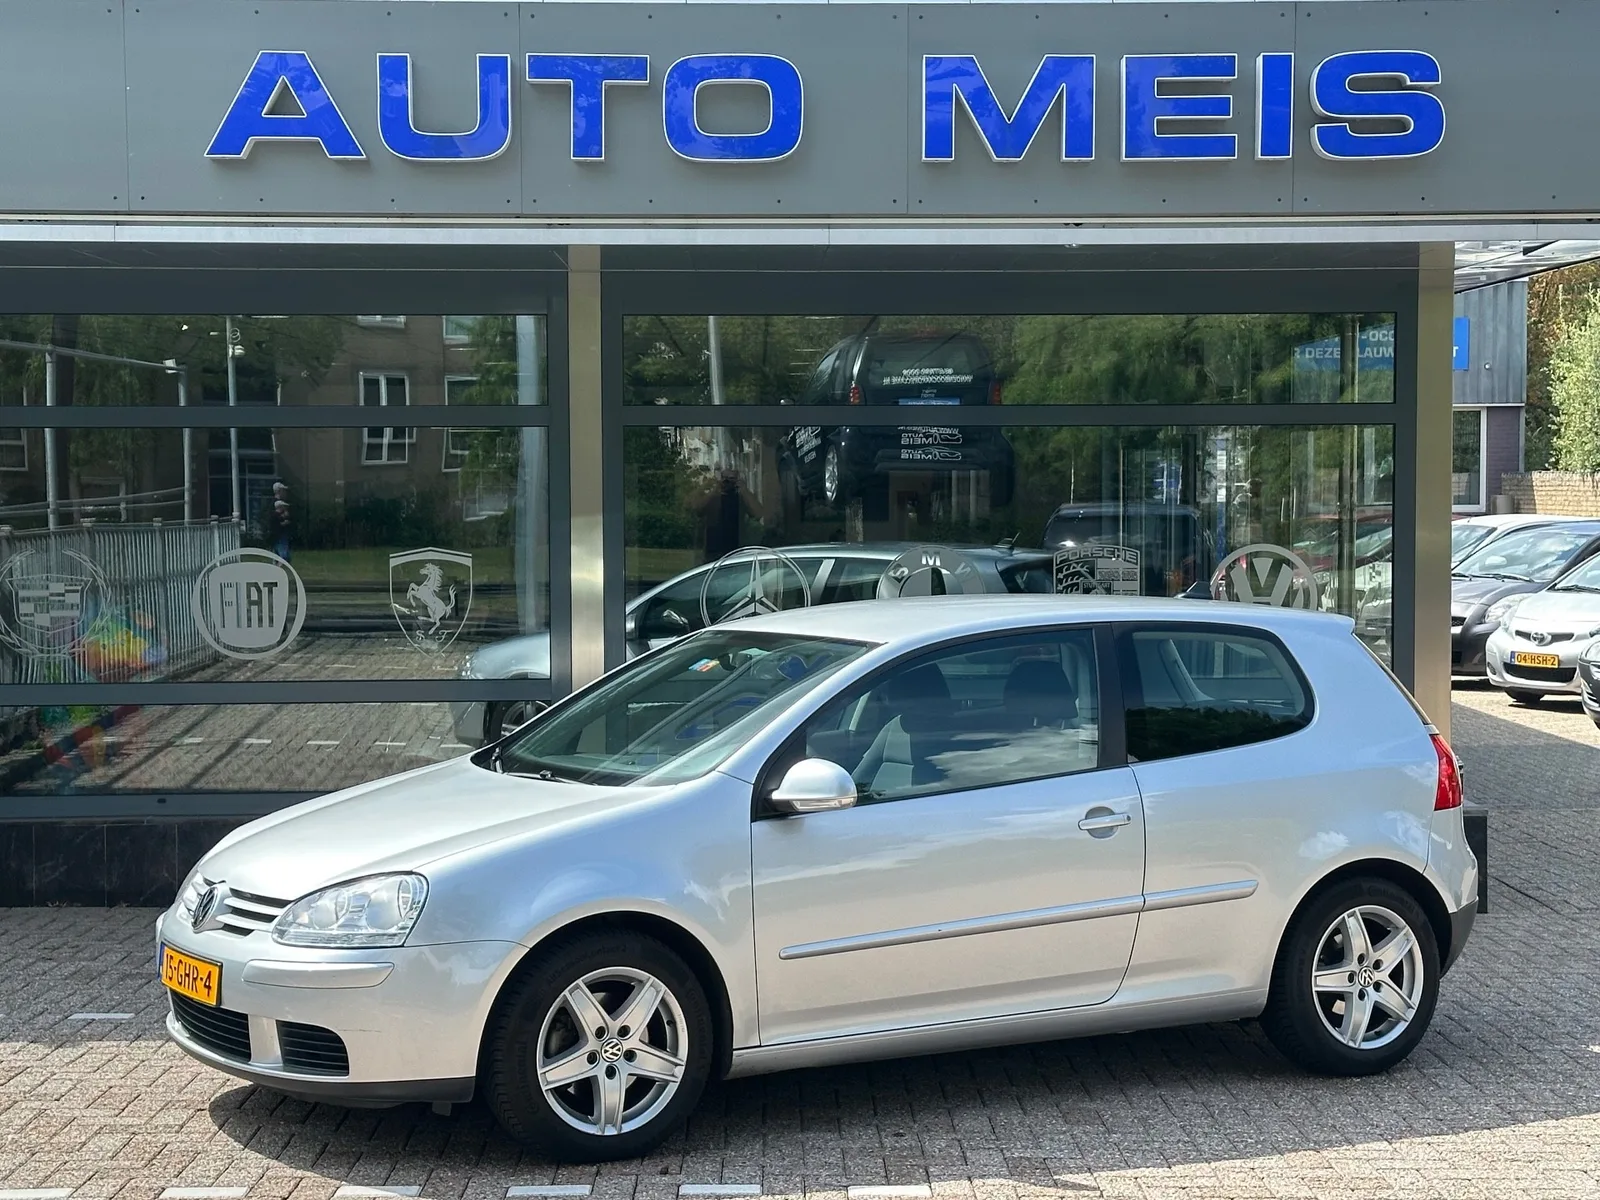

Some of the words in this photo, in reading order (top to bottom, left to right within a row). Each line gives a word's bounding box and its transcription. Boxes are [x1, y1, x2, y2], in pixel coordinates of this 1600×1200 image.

[203, 50, 804, 163] AUTO
[921, 50, 1446, 162] MEIS
[1305, 347, 1341, 359] DEZE
[1056, 547, 1138, 565] PORSCHE
[219, 581, 278, 628] FIAT
[1516, 653, 1557, 667] 04-HSH-2
[165, 952, 212, 998] 15-GHR-4
